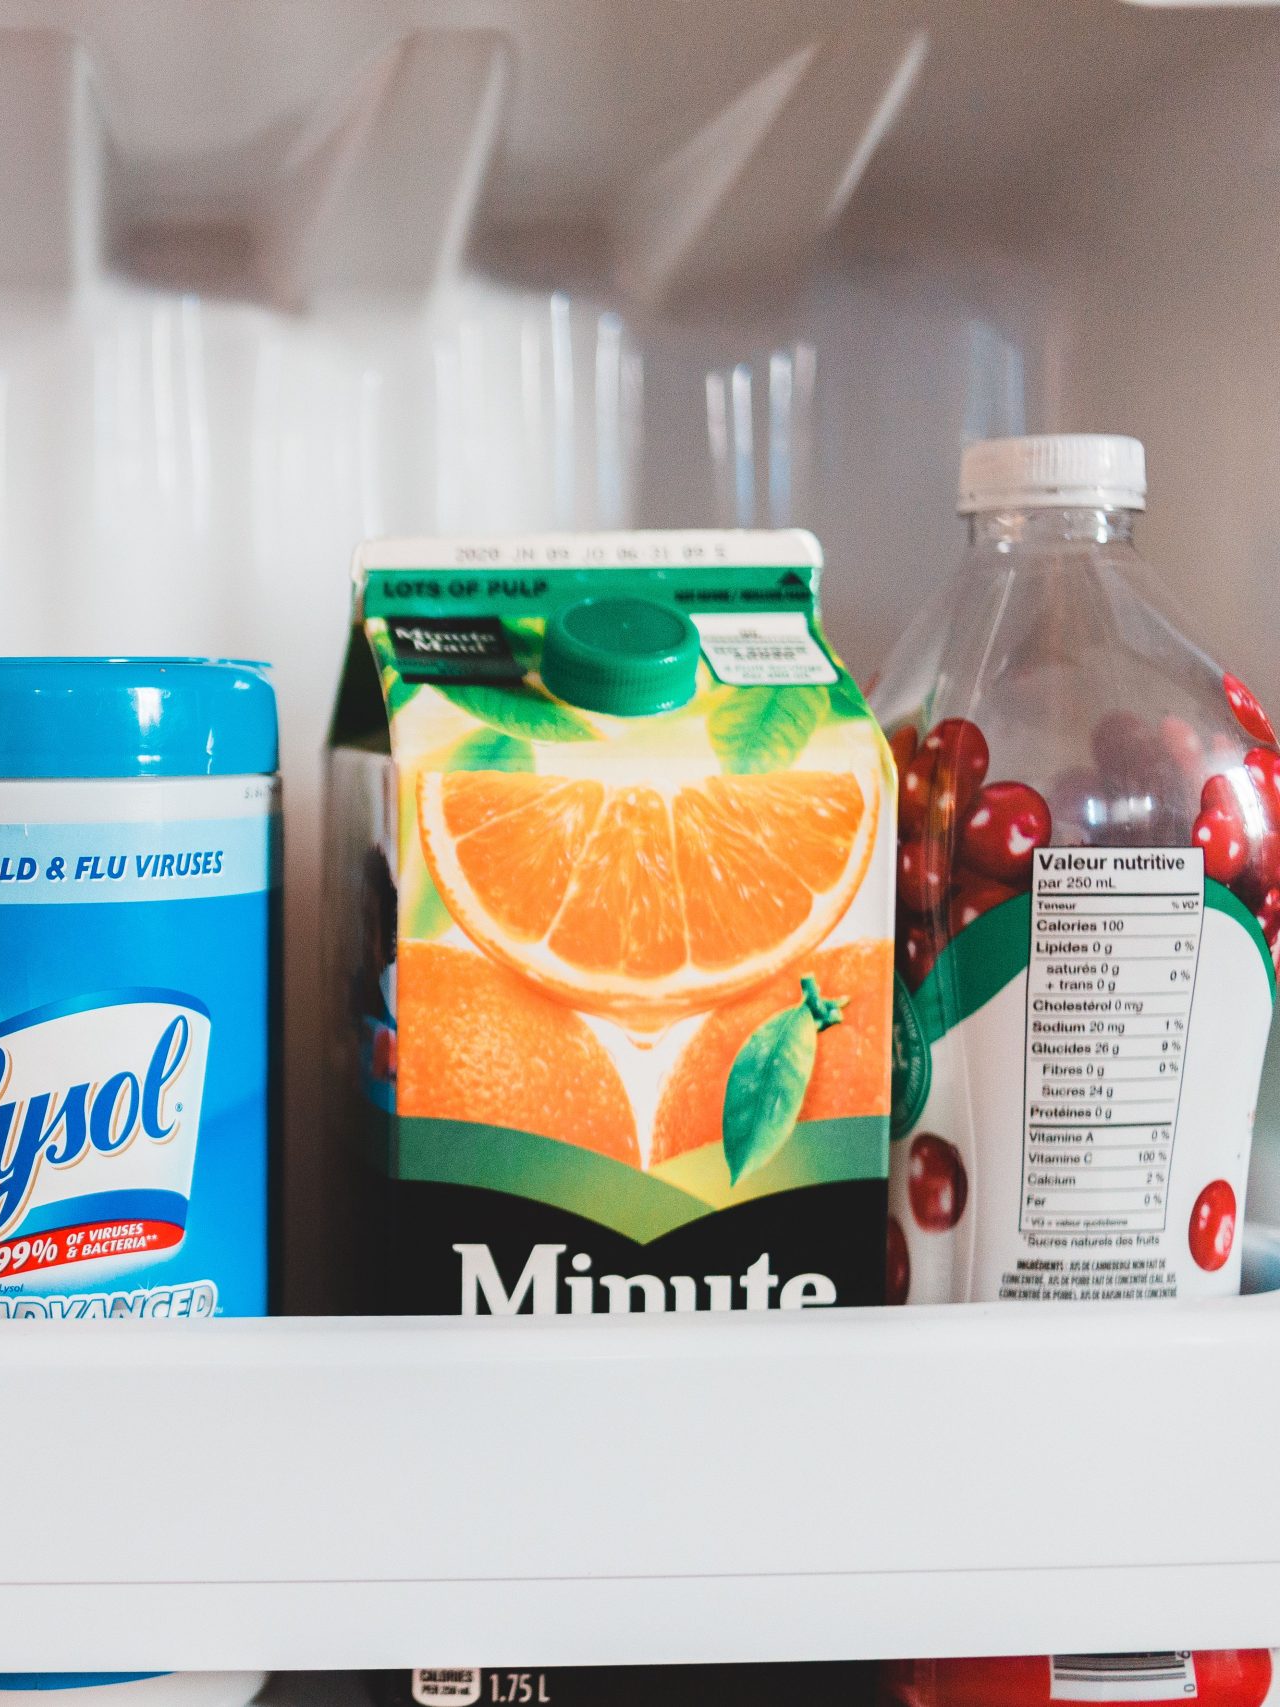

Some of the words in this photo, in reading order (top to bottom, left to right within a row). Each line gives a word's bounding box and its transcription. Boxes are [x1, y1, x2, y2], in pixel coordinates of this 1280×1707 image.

[383, 579, 441, 598] LOTS
[448, 578, 479, 598] OF
[487, 577, 549, 598] PULP
[45, 858, 66, 882] &
[74, 855, 129, 881] FLU
[134, 850, 224, 879] VIRUSES
[1039, 853, 1108, 871] Valeur
[1113, 854, 1185, 871] nutritive
[1038, 878, 1062, 891] par
[1066, 877, 1092, 889] 250
[1096, 877, 1116, 888] mL
[1037, 901, 1076, 911] Teneur
[1037, 920, 1097, 931] Calories
[1102, 920, 1124, 931] 100
[1036, 942, 1088, 955] Lipides
[1092, 942, 1101, 953] 0
[1047, 963, 1097, 974] saturés
[1101, 963, 1108, 974] 0
[1112, 965, 1120, 976] g
[1169, 971, 1177, 981] 0
[1059, 979, 1093, 990] trans
[1097, 980, 1105, 990] 0
[1108, 981, 1116, 992] g
[1033, 999, 1111, 1012] Cholestérol
[1032, 1021, 1085, 1033] Sodium
[1089, 1021, 1105, 1033] 20
[1108, 1023, 1125, 1035] mg
[1032, 1041, 1091, 1054] Glucides
[1042, 1064, 1082, 1075] Fibres
[1042, 1085, 1085, 1097] Sucres
[1089, 1085, 1103, 1097] 24
[1030, 1106, 1091, 1118] Protéines
[1030, 1131, 1082, 1143] Vitamine
[1086, 1131, 1095, 1142] A
[1028, 1152, 1080, 1164] Vitamine
[1084, 1152, 1093, 1164] C
[1138, 1152, 1155, 1162] 100
[1027, 1174, 1076, 1186] Calcium
[66, 1232, 86, 1246] OF
[88, 1223, 144, 1242] VIRUSES
[66, 1246, 76, 1258] &
[452, 1243, 837, 1315] Minute
[490, 1673, 532, 1703] 1.75
[538, 1673, 551, 1703] L
